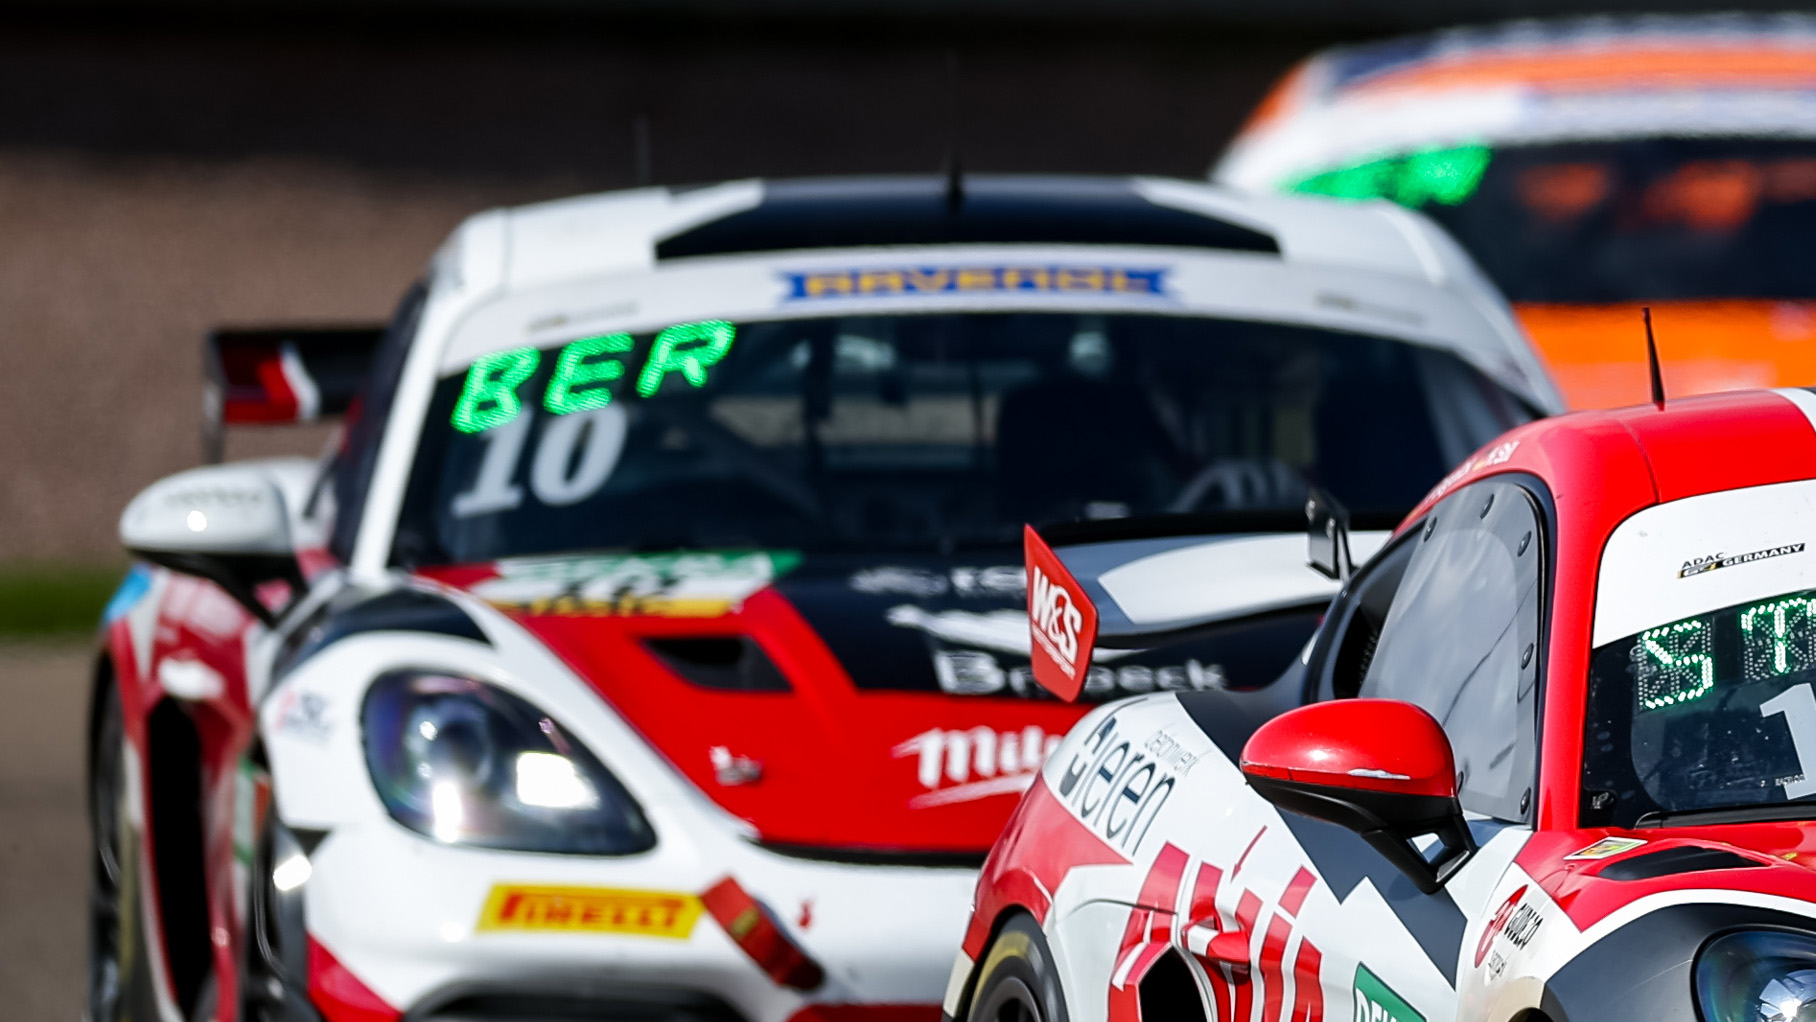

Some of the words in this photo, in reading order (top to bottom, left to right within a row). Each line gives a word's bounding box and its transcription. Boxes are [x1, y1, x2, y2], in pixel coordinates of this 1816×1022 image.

[450, 319, 736, 434] BER
[453, 398, 628, 518] 10
[1682, 551, 1725, 570] ADAC
[1721, 543, 1802, 567] GERMANY
[1032, 564, 1083, 665] W&S
